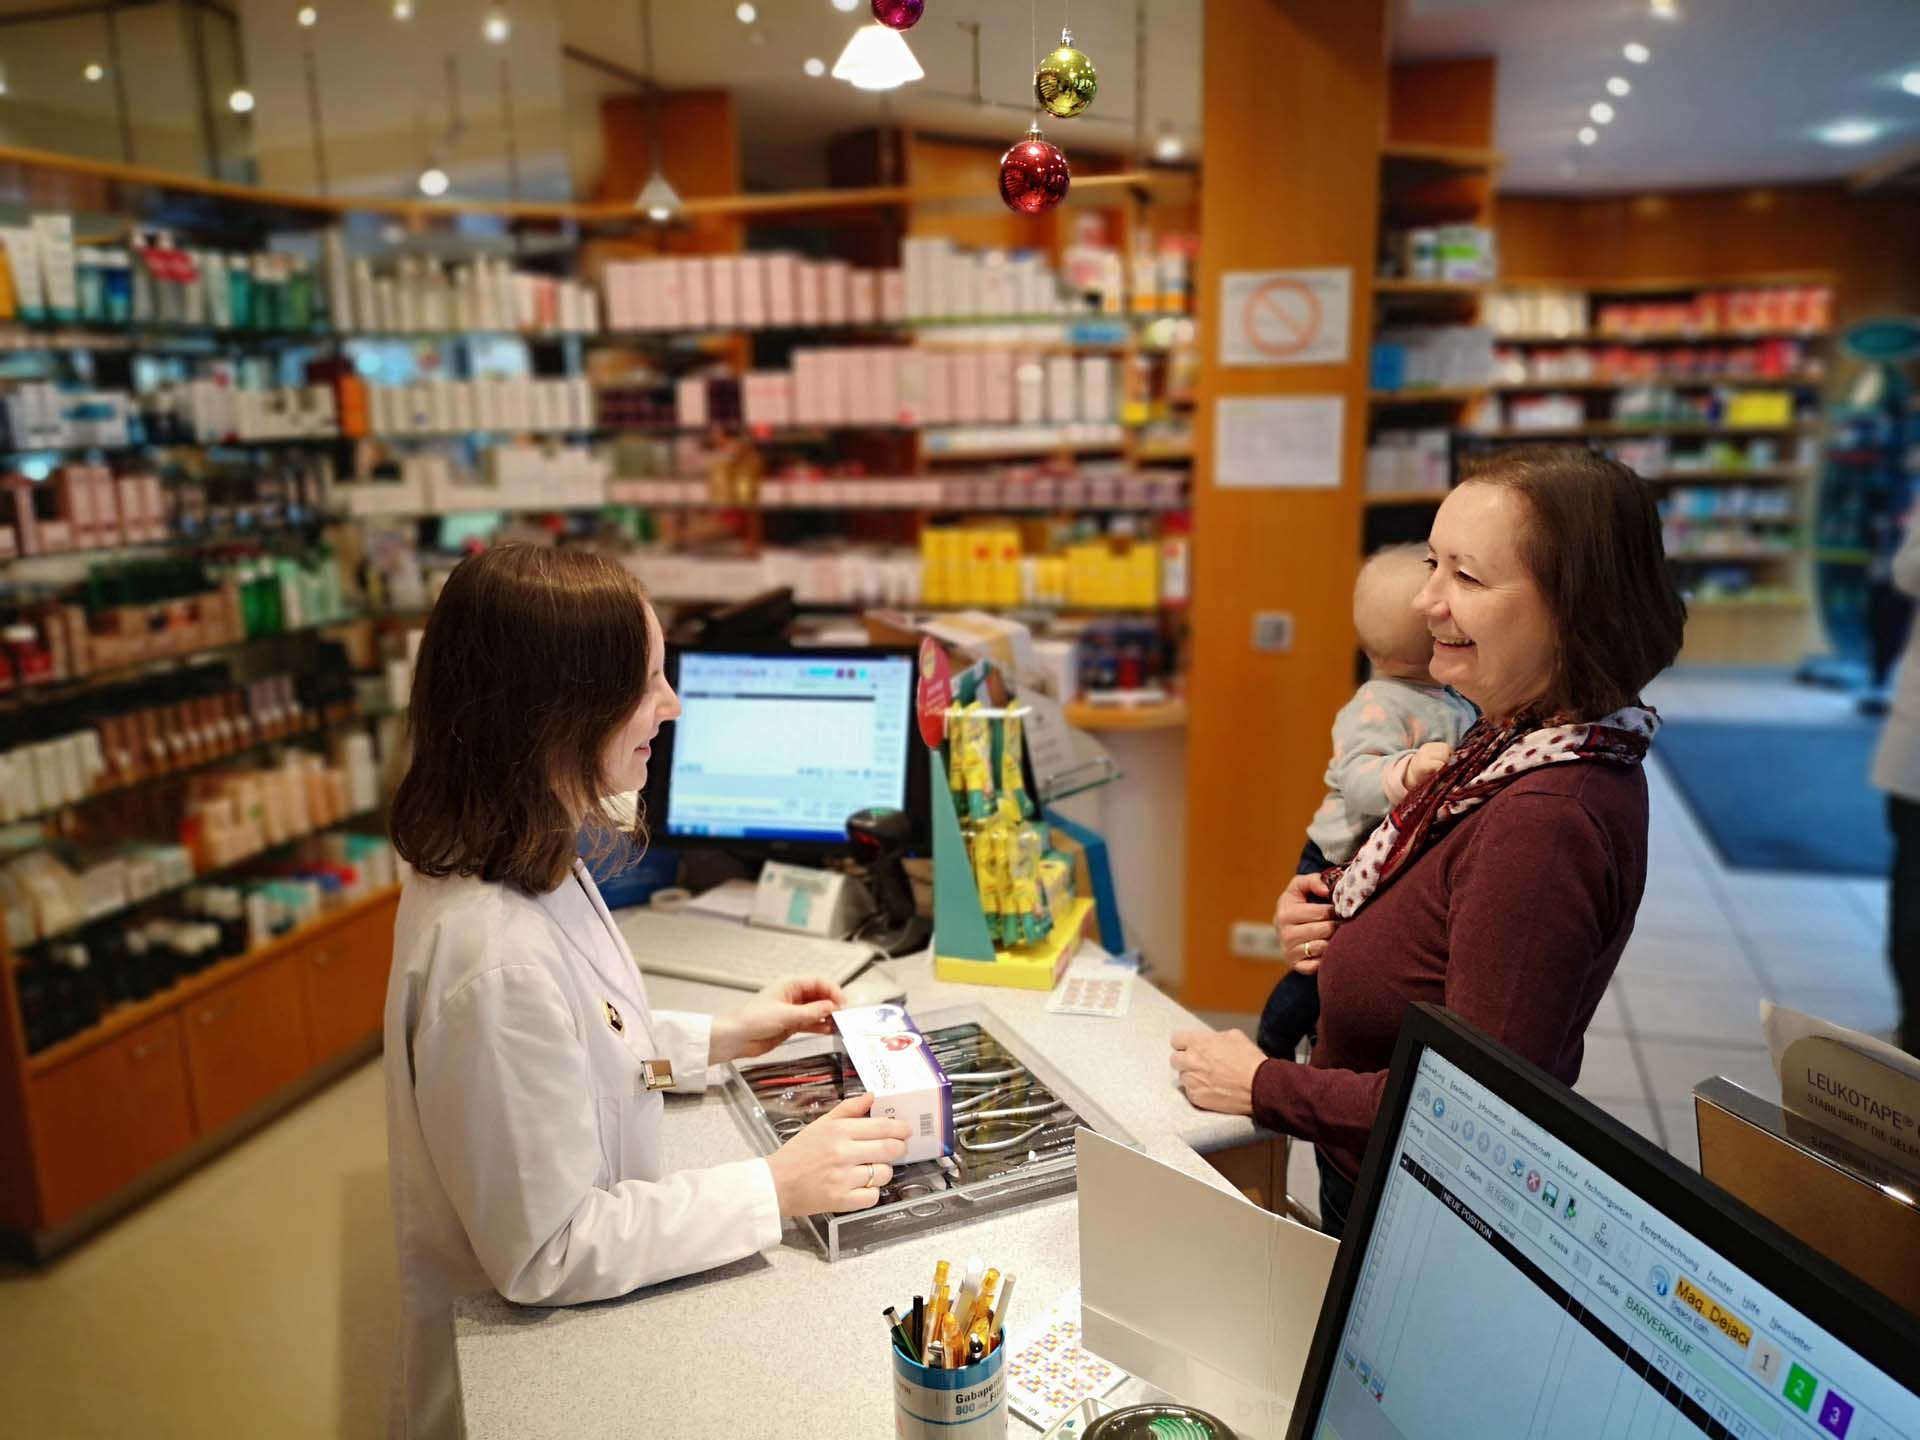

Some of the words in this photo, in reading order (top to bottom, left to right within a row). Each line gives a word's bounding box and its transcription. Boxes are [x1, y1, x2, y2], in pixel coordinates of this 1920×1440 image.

[1443, 1191, 1461, 1214] NEUE
[1461, 1207, 1493, 1240] POSITION
[1625, 1295, 1695, 1356] BARVERKAUF
[1769, 1316, 1812, 1352] Newsletter
[1760, 1353, 1770, 1372] 1
[1793, 1379, 1805, 1398] 2
[955, 1404, 976, 1416] 800
[1829, 1406, 1841, 1427] 3
